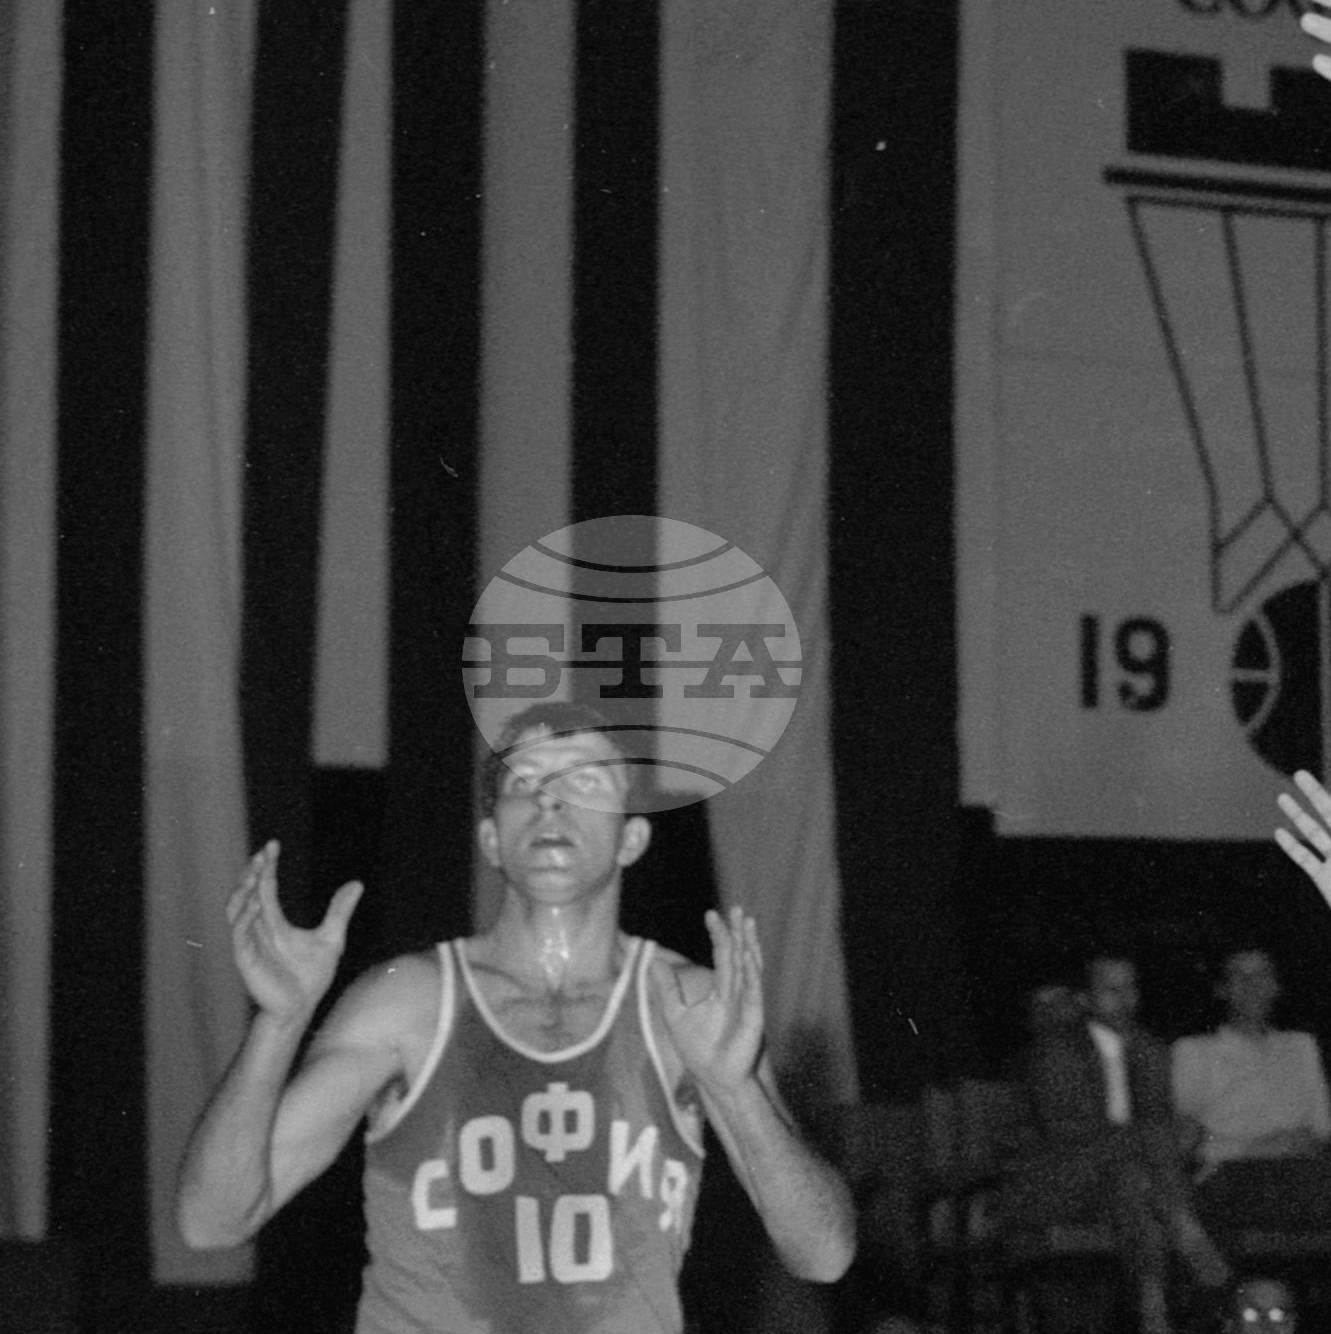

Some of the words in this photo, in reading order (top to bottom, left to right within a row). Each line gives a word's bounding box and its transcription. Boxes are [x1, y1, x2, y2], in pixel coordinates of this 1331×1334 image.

[1079, 612, 1172, 711] 19
[411, 1081, 689, 1234] СОФИЯ
[514, 1193, 614, 1285] 10
